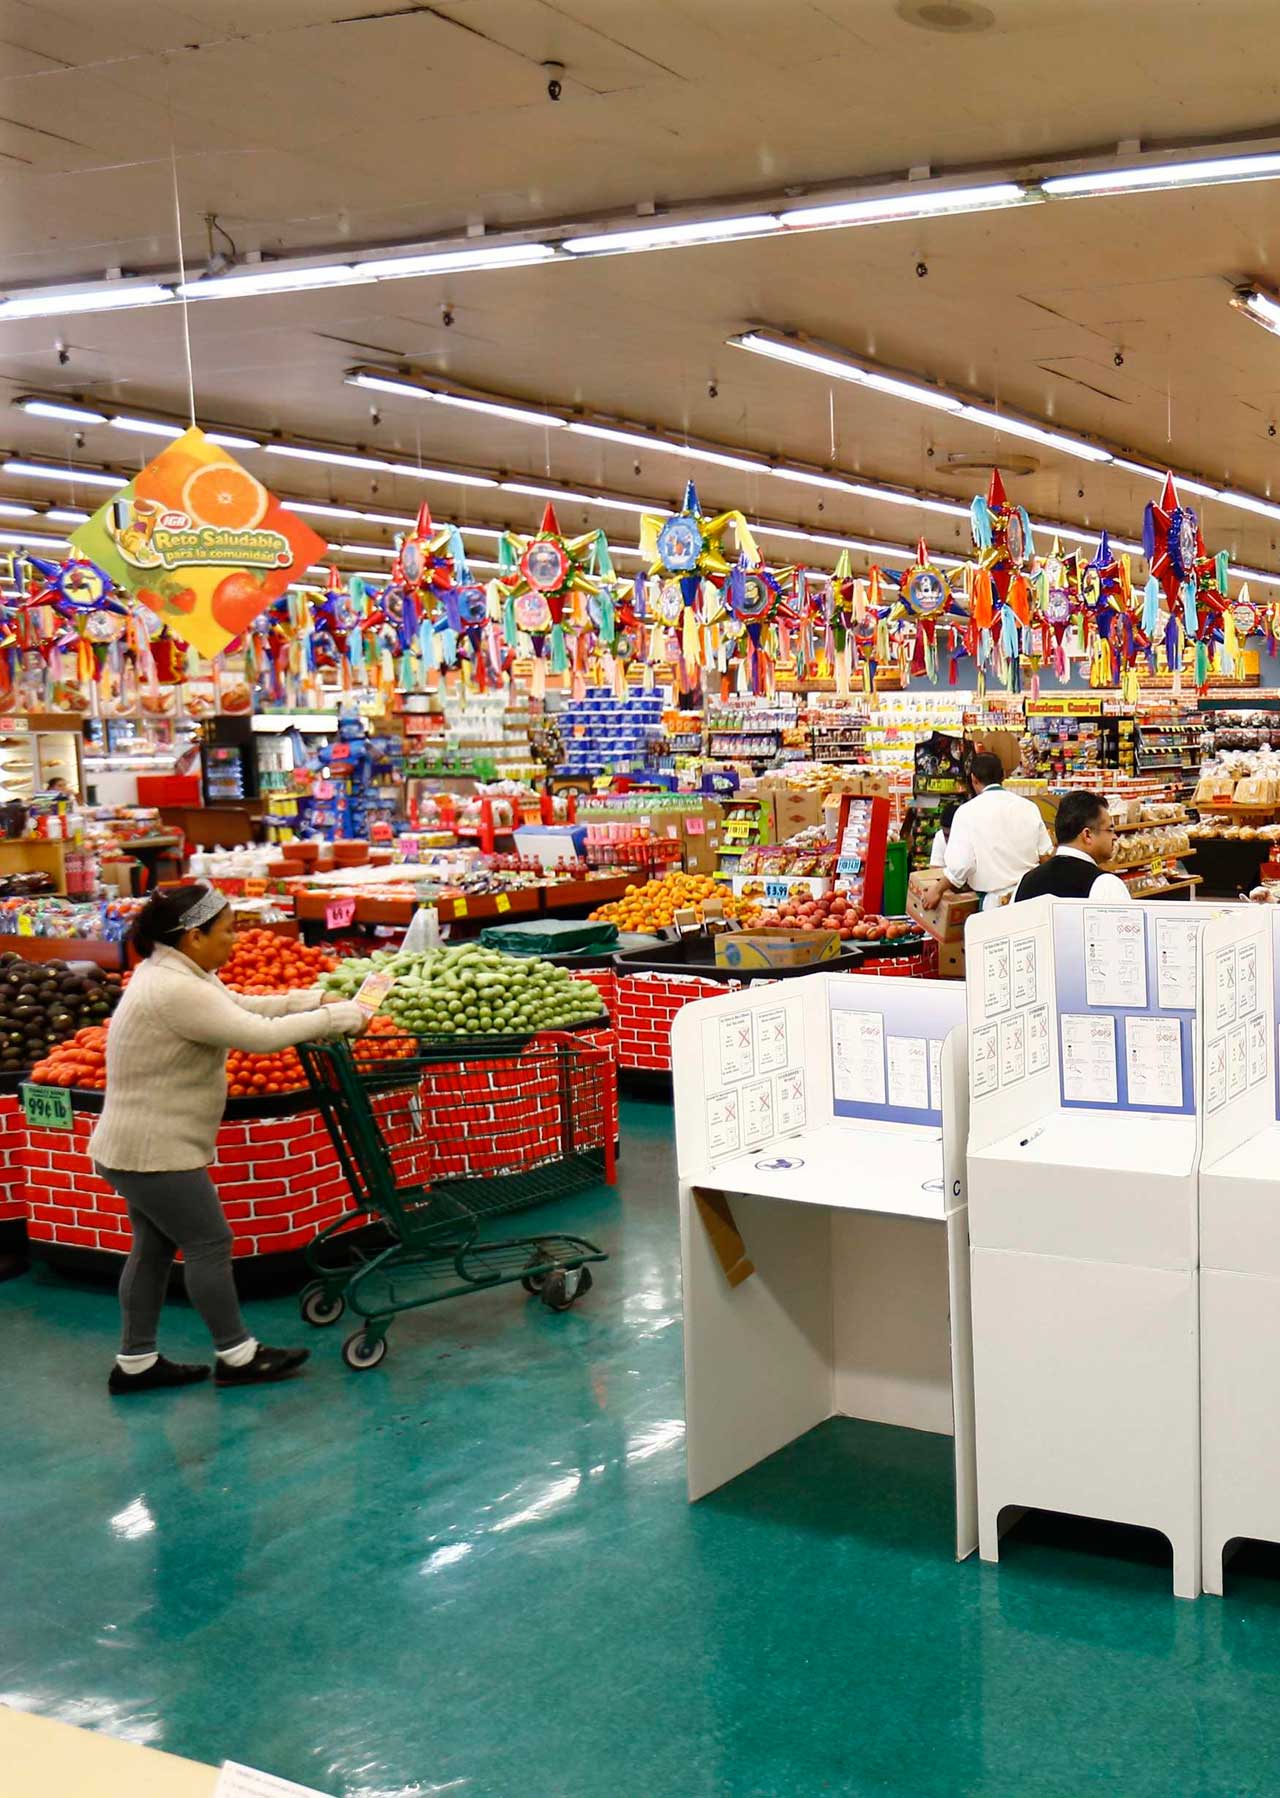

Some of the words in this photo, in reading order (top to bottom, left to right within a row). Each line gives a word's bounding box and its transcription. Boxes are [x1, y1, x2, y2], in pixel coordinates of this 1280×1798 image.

[163, 515, 187, 527] IGA
[155, 532, 199, 549] Reto
[202, 529, 282, 550] Saludable
[166, 550, 193, 561] para
[196, 549, 207, 558] la
[210, 550, 275, 561] comunidad
[54, 1099, 66, 1118] lb
[952, 1179, 961, 1197] C
